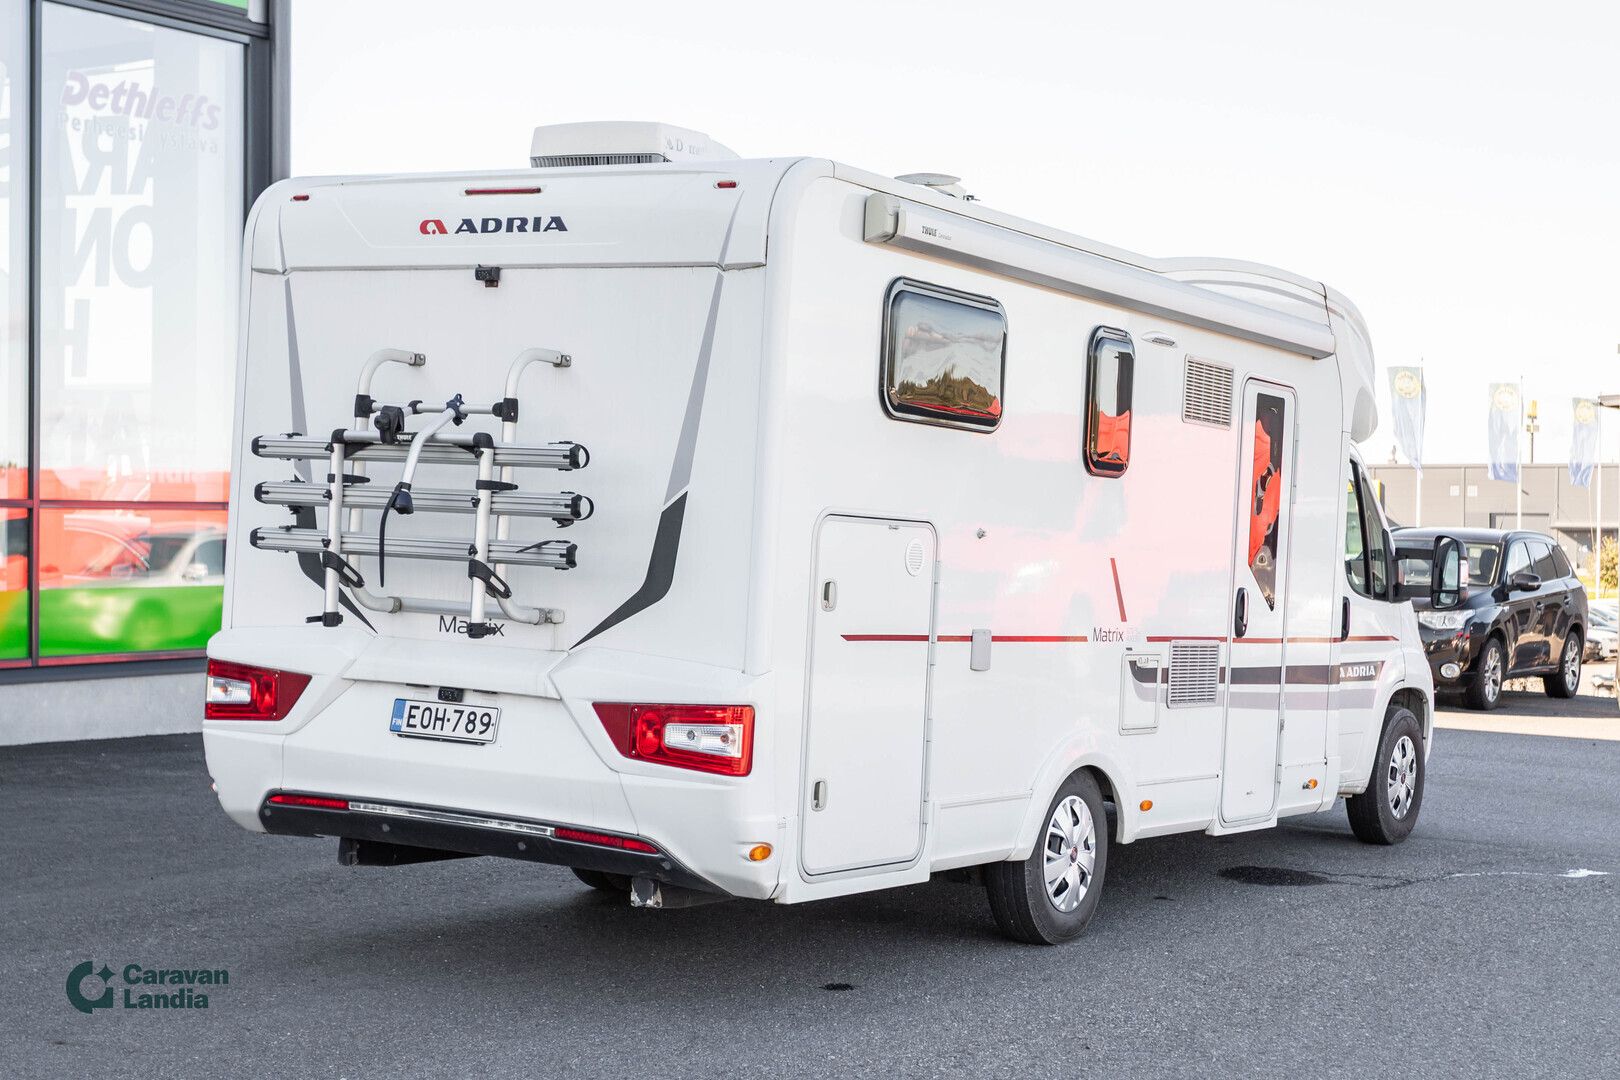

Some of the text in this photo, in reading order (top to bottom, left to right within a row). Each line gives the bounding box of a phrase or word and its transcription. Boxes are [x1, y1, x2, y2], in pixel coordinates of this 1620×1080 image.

[62, 70, 222, 130] Dethleffs
[454, 215, 569, 234] ADRIA
[1092, 626, 1124, 643] Matrix
[1346, 665, 1376, 678] ADRIA
[406, 704, 492, 736] EOH-789
